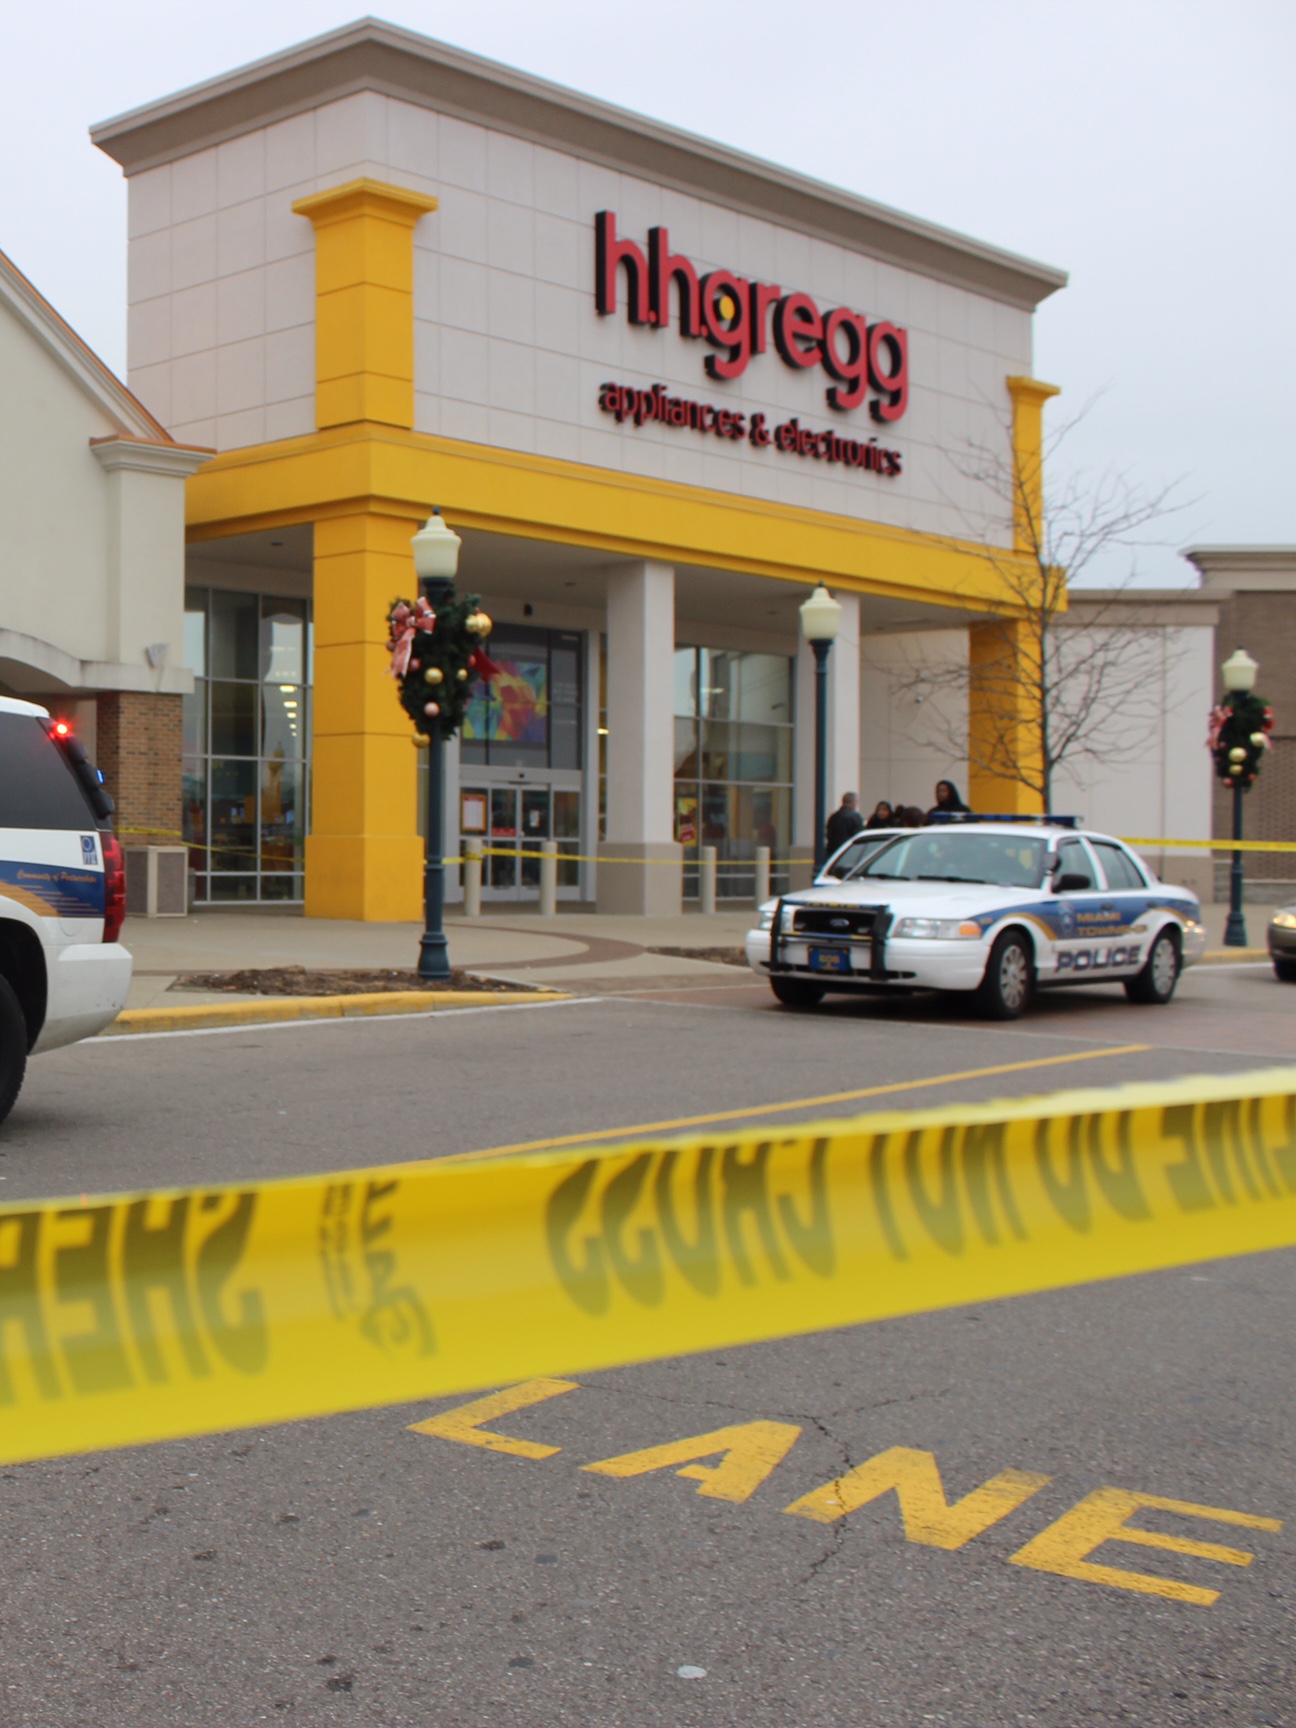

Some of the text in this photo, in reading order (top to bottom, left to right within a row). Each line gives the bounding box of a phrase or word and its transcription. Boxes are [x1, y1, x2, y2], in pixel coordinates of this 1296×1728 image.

[598, 381, 902, 476] appliances & electronics
[1078, 912, 1121, 922] MIAMI
[1055, 946, 1141, 973] POLICE
[407, 1378, 1284, 1607] LANE
